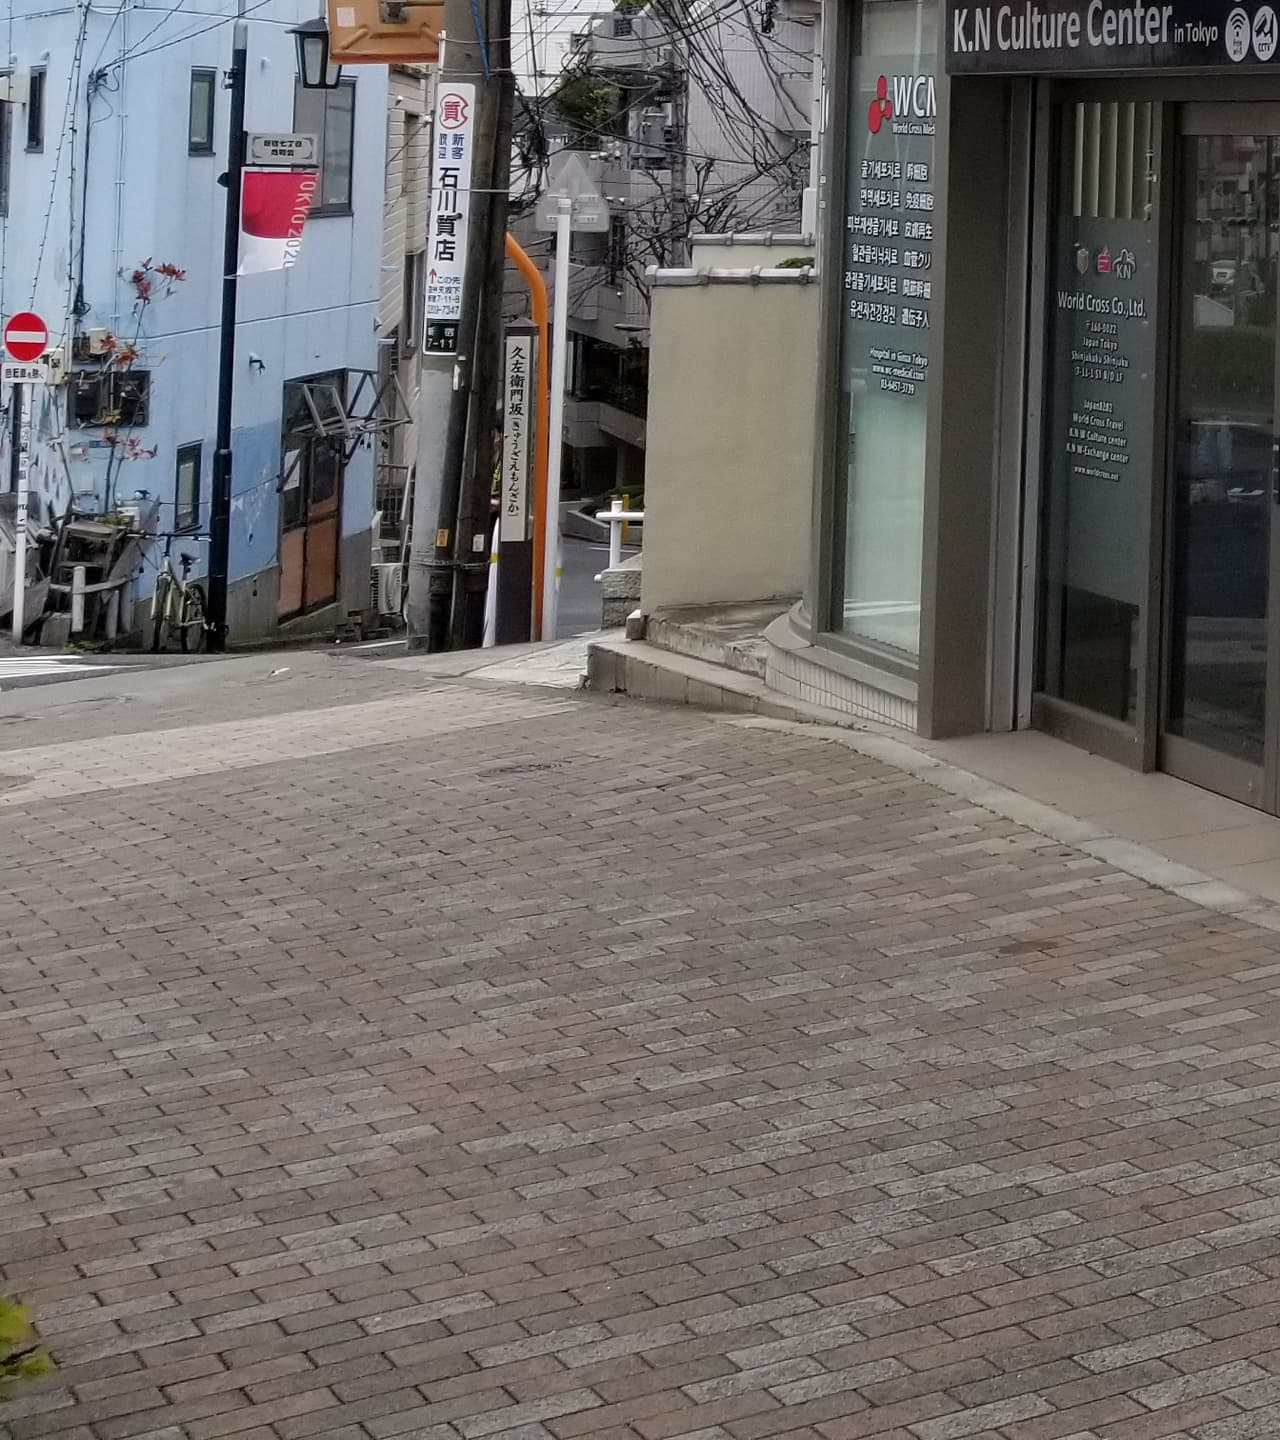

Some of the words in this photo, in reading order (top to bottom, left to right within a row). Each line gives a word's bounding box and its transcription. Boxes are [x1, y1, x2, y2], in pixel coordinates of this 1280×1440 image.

[952, 6, 991, 53] K.N
[995, 0, 1082, 51] Culture
[1174, 23, 1186, 43] in
[1186, 21, 1219, 50] Tokyo
[290, 171, 319, 224] TOKYO
[434, 167, 461, 261] 石川質店
[1057, 291, 1085, 310] World
[1086, 294, 1111, 313] Cross
[427, 338, 454, 349] 7-11
